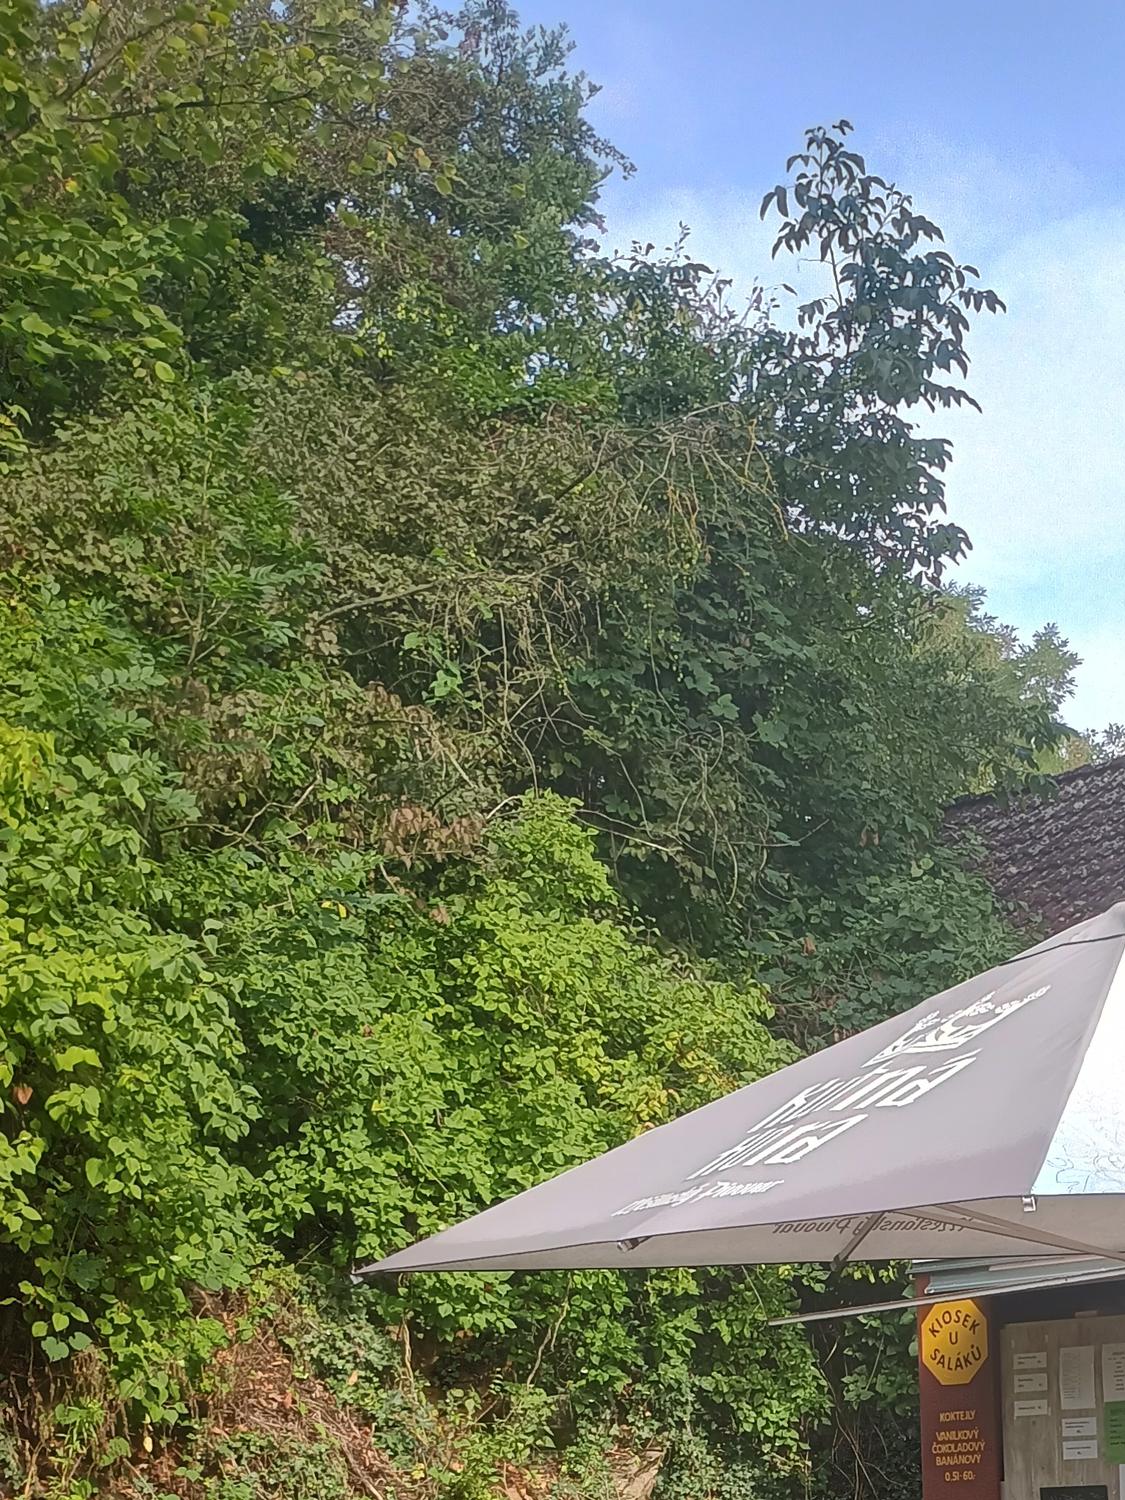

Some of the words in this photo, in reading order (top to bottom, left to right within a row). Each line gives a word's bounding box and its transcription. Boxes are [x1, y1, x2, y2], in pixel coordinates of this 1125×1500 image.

[929, 1309, 980, 1338] KIOSEK
[949, 1331, 958, 1345] U
[930, 1344, 982, 1371] SALÁKŮ
[939, 1409, 976, 1422] KOKTEJLY
[936, 1426, 979, 1441] VANILKOVÝ
[936, 1452, 981, 1466] BANÁNOVÝ
